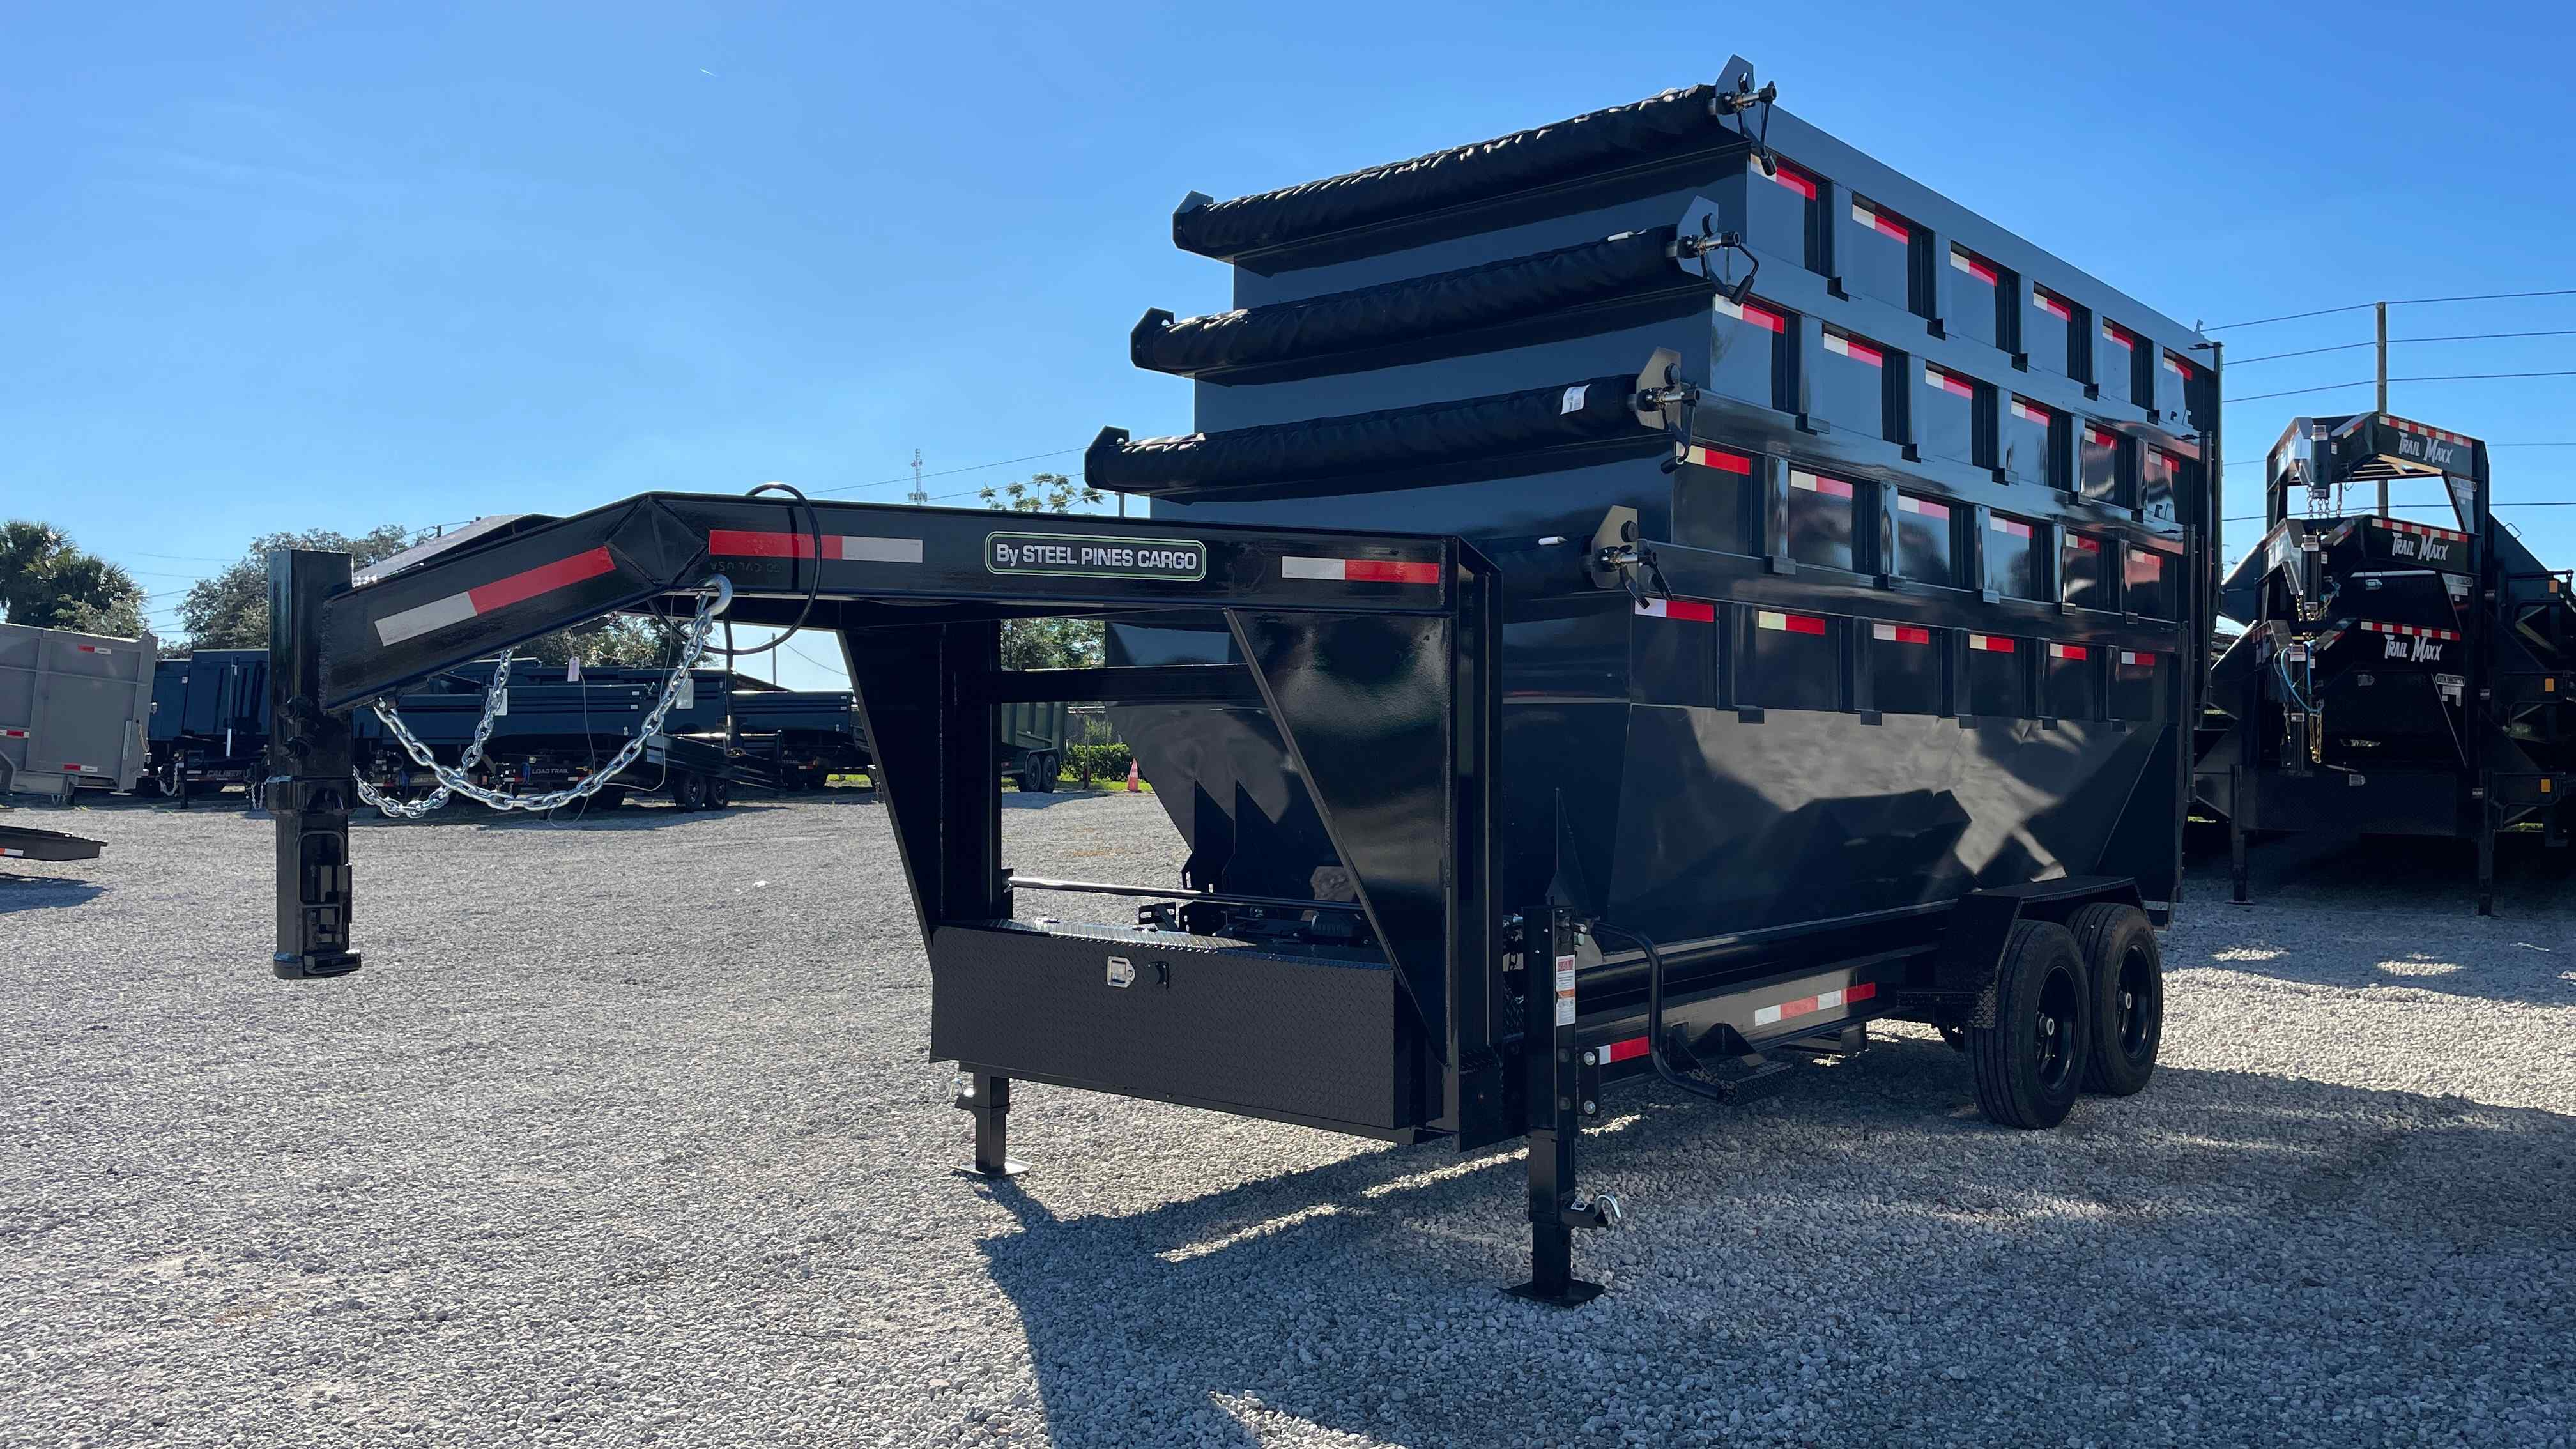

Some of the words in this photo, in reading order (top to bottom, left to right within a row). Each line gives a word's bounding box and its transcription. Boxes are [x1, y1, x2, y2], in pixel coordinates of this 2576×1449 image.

[996, 544, 1018, 567] By
[1022, 545, 1077, 565] STEEL
[1081, 548, 1133, 567] PINES
[1137, 550, 1197, 569] CARGO
